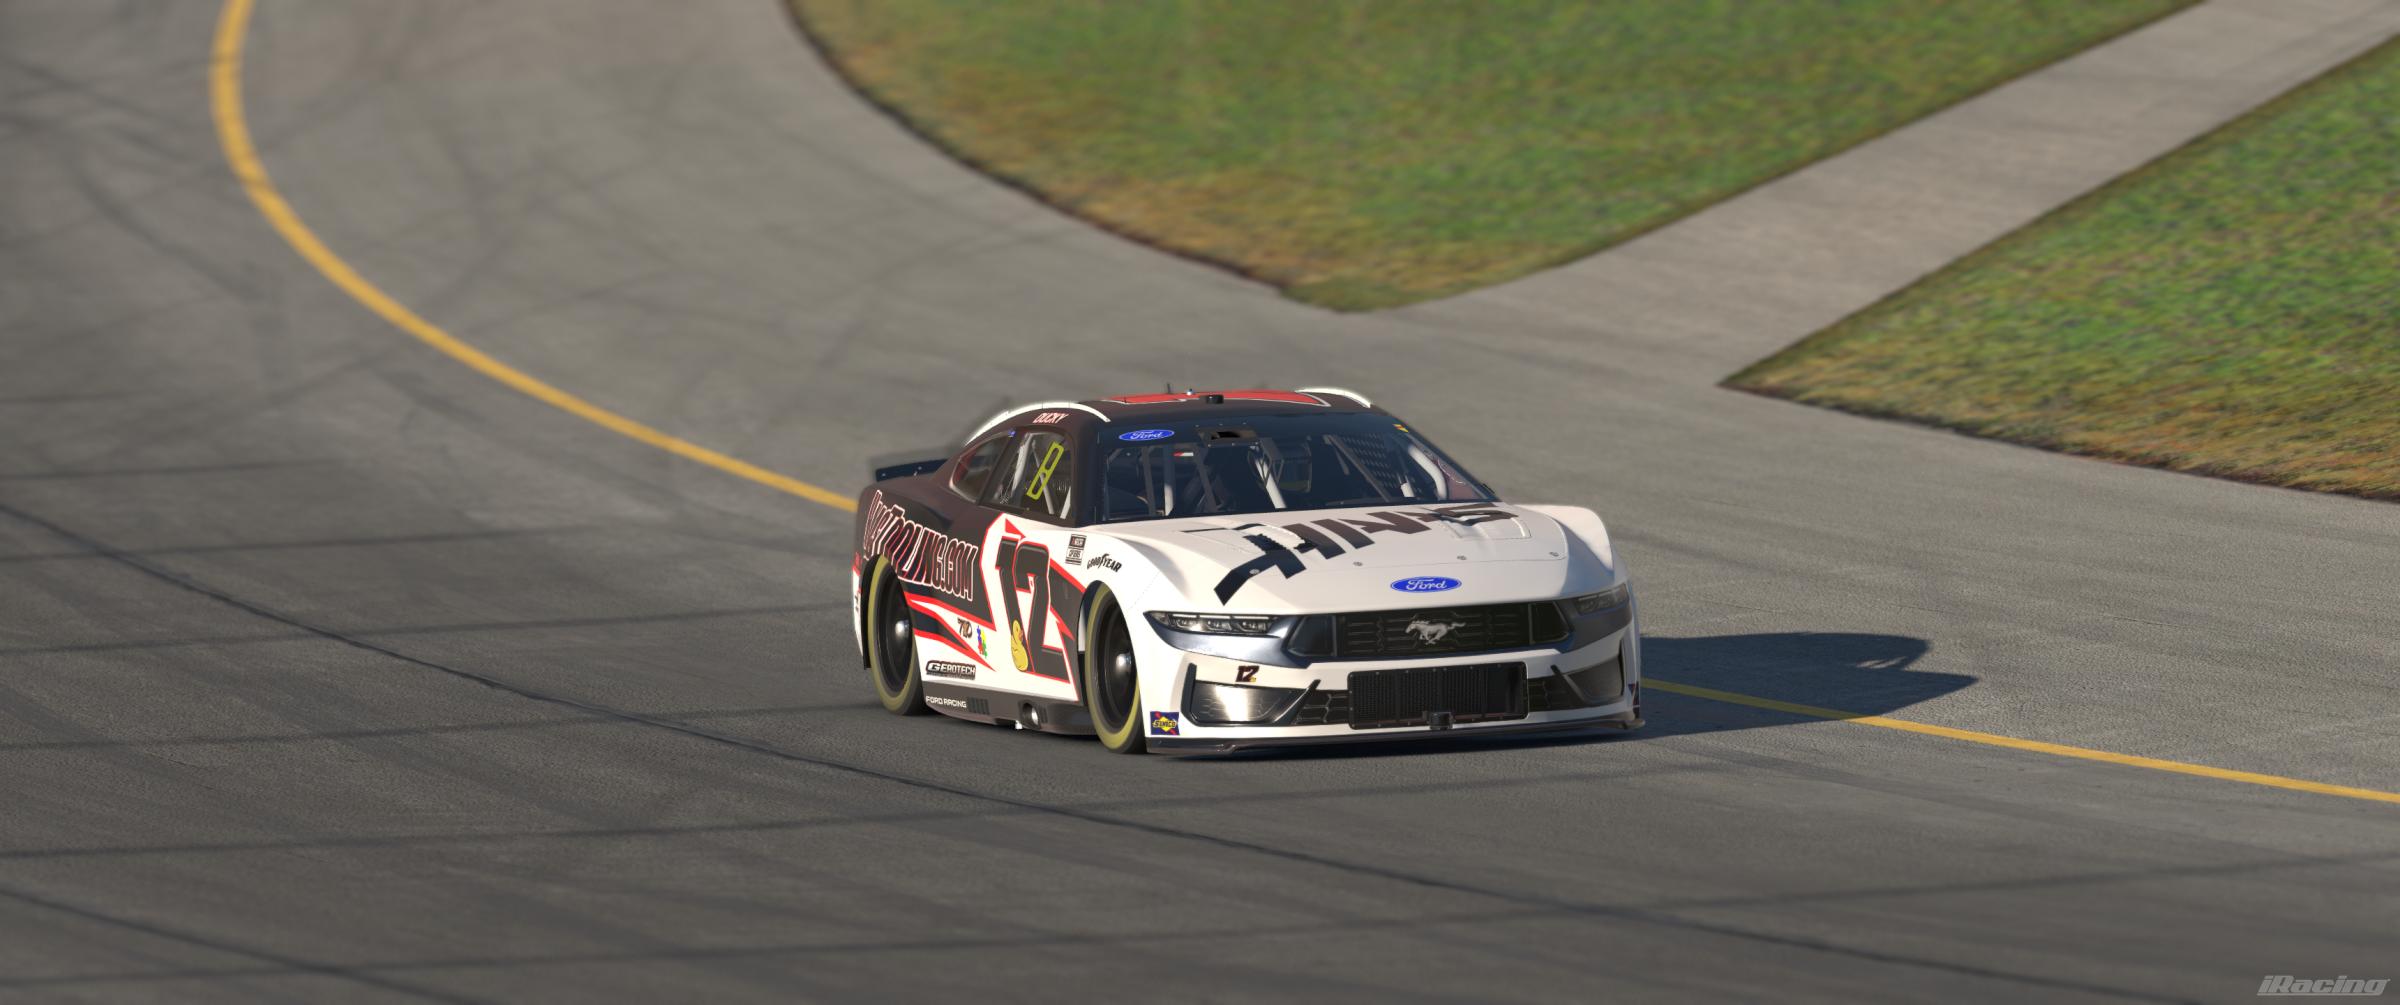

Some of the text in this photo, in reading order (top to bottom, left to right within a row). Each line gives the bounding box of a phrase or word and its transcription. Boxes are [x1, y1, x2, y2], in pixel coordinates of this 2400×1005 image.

[1032, 412, 1069, 424] DUCKY
[1086, 553, 1123, 572] GOODYEAR
[995, 535, 1072, 684] 12
[927, 662, 976, 676] GEROTECH
[1235, 665, 1260, 683] 12
[925, 695, 967, 708] FORD RACING
[1152, 719, 1177, 728] SUNOCO
